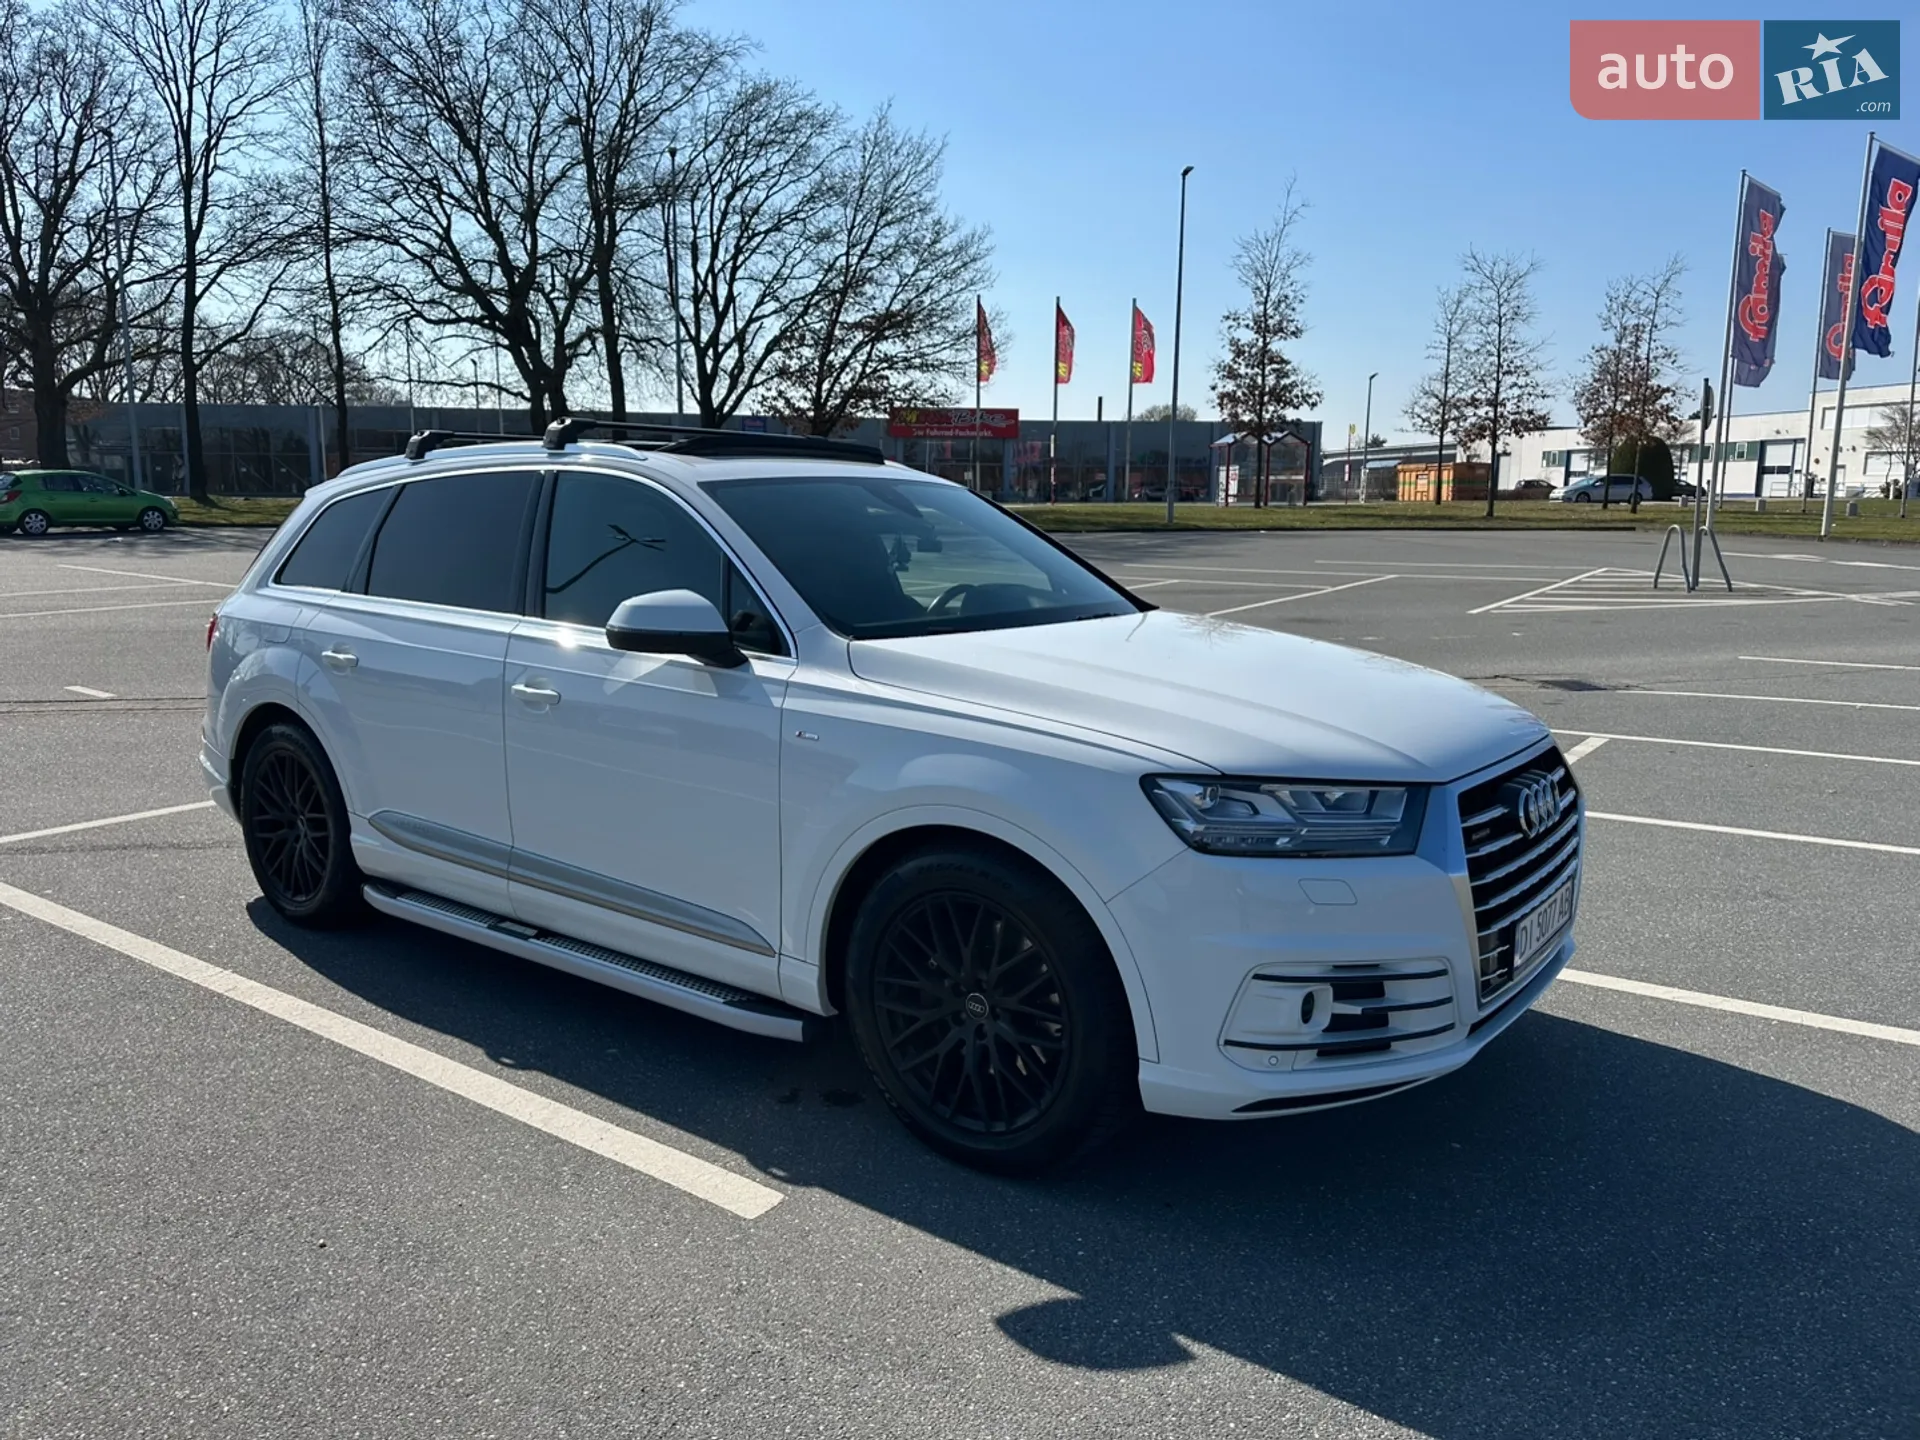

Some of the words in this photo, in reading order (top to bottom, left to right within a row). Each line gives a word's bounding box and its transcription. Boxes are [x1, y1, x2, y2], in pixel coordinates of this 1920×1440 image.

[1738, 208, 1774, 342] famila
[1518, 919, 1533, 960] DI
[1536, 898, 1557, 942] 5077
[1557, 887, 1571, 923] AB
